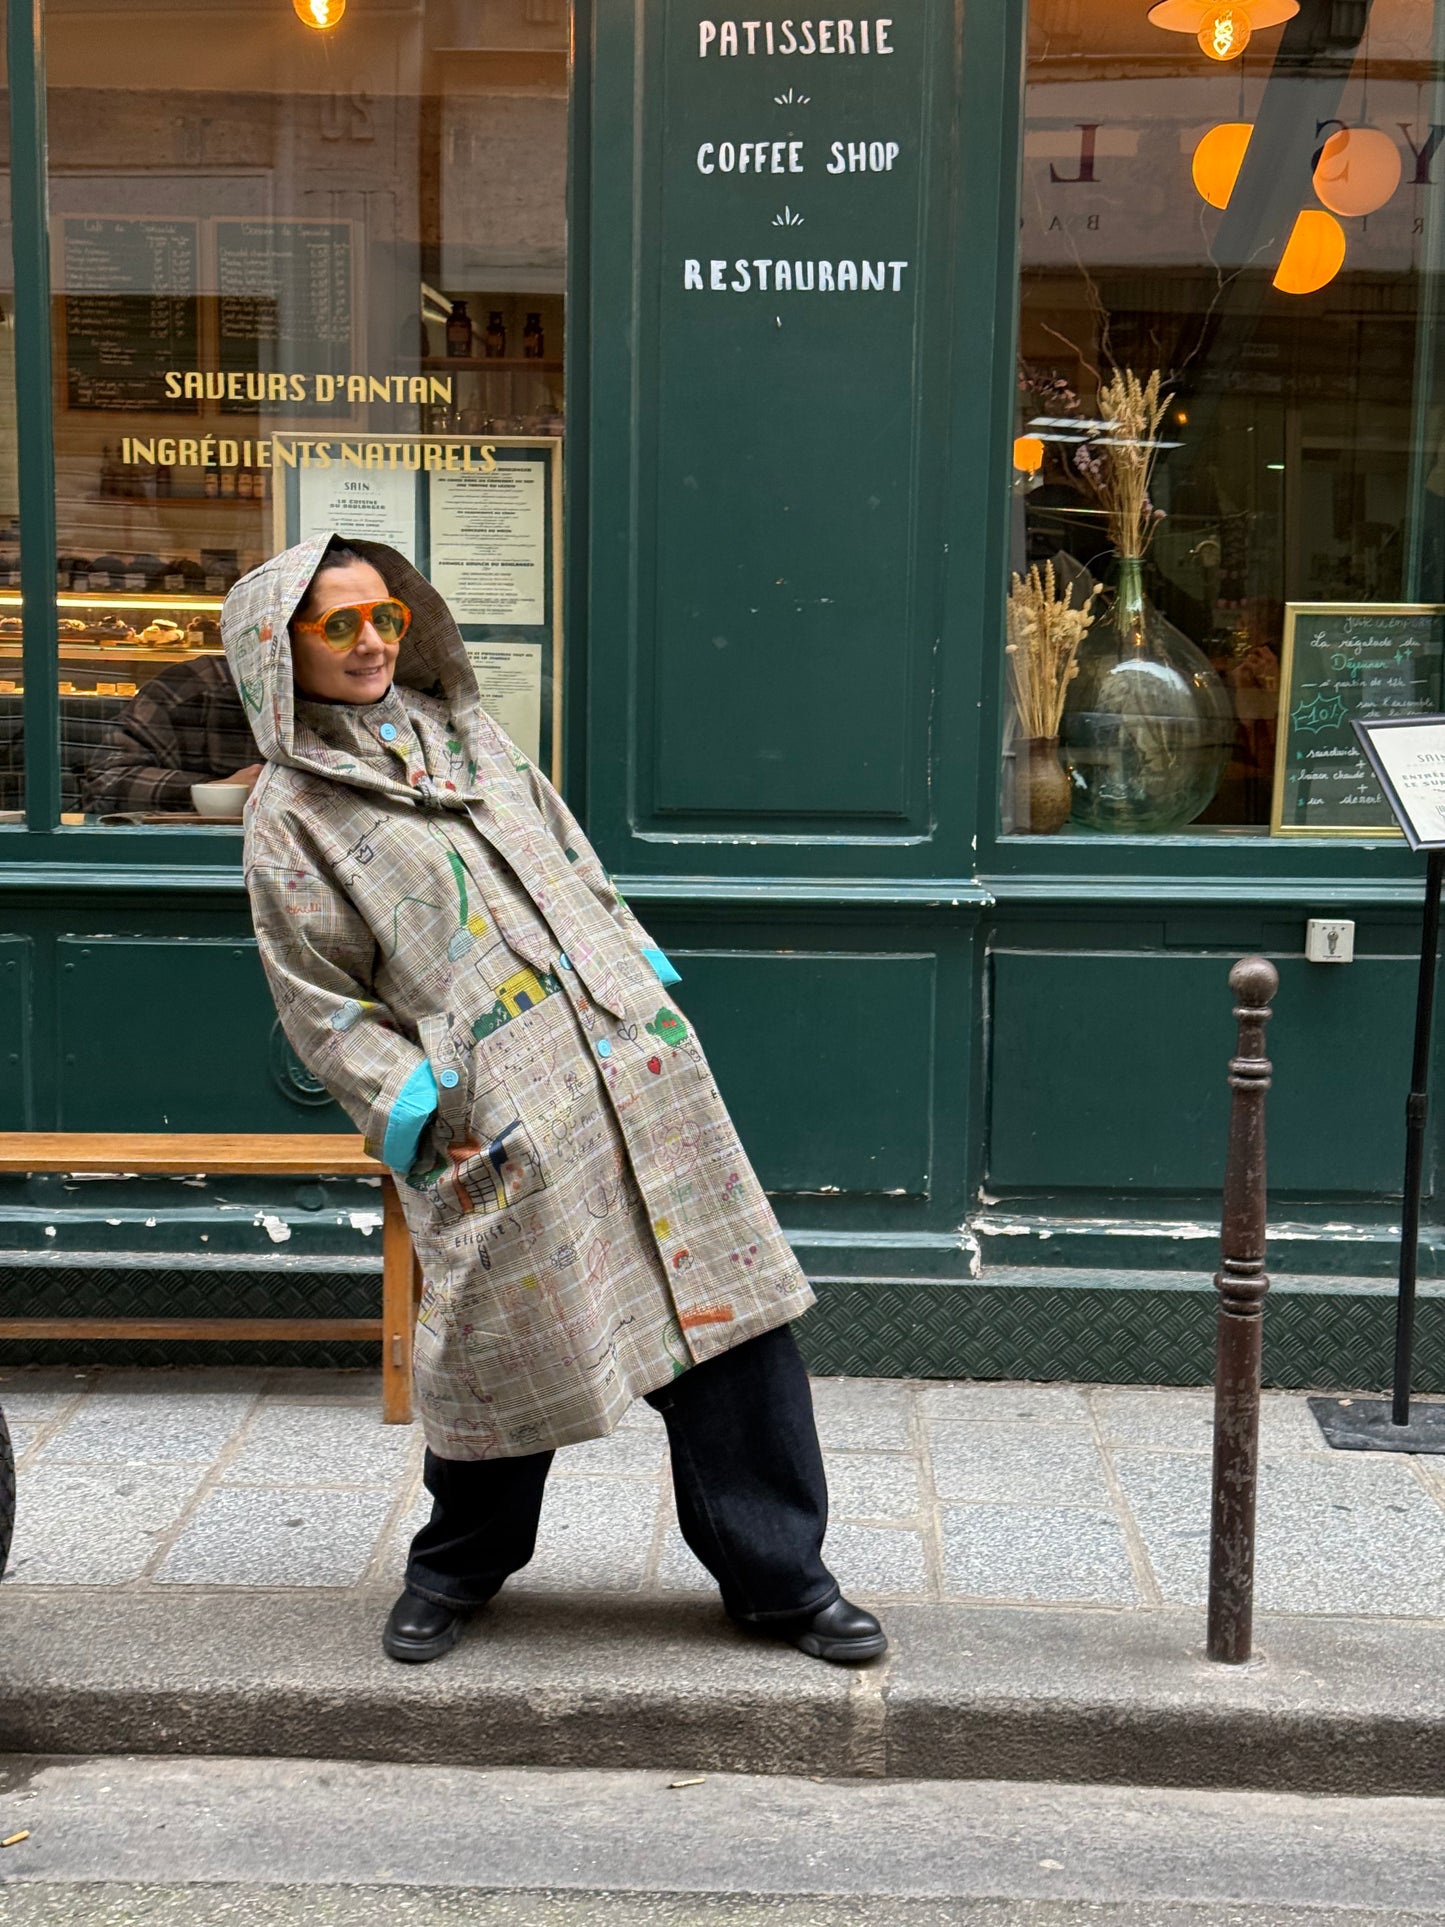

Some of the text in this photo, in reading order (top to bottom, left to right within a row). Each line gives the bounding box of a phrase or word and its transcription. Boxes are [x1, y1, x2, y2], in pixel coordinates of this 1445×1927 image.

[700, 19, 893, 57] PATISSERIE
[697, 142, 900, 174] COFFEE SHOP
[685, 260, 907, 293] RESTAURANT
[165, 372, 306, 401] SAVEURS
[122, 433, 497, 472] INGRÉDIENTS NATURELS
[344, 481, 370, 491] SAIN
